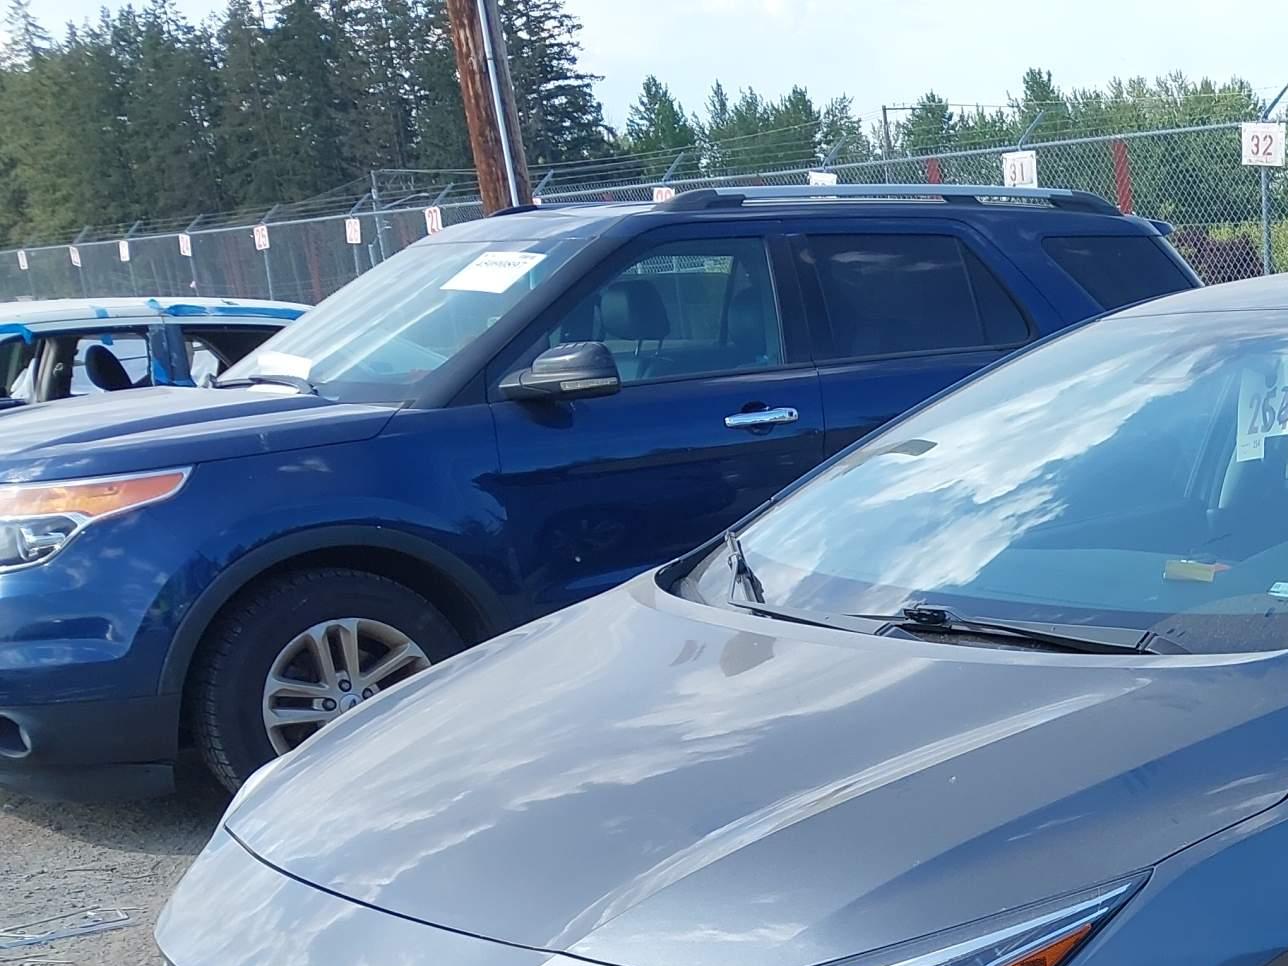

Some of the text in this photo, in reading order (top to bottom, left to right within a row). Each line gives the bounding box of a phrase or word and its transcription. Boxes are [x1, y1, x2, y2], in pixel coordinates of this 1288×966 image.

[1251, 134, 1273, 156] 32
[1009, 161, 1025, 182] 31
[255, 228, 268, 249] 25
